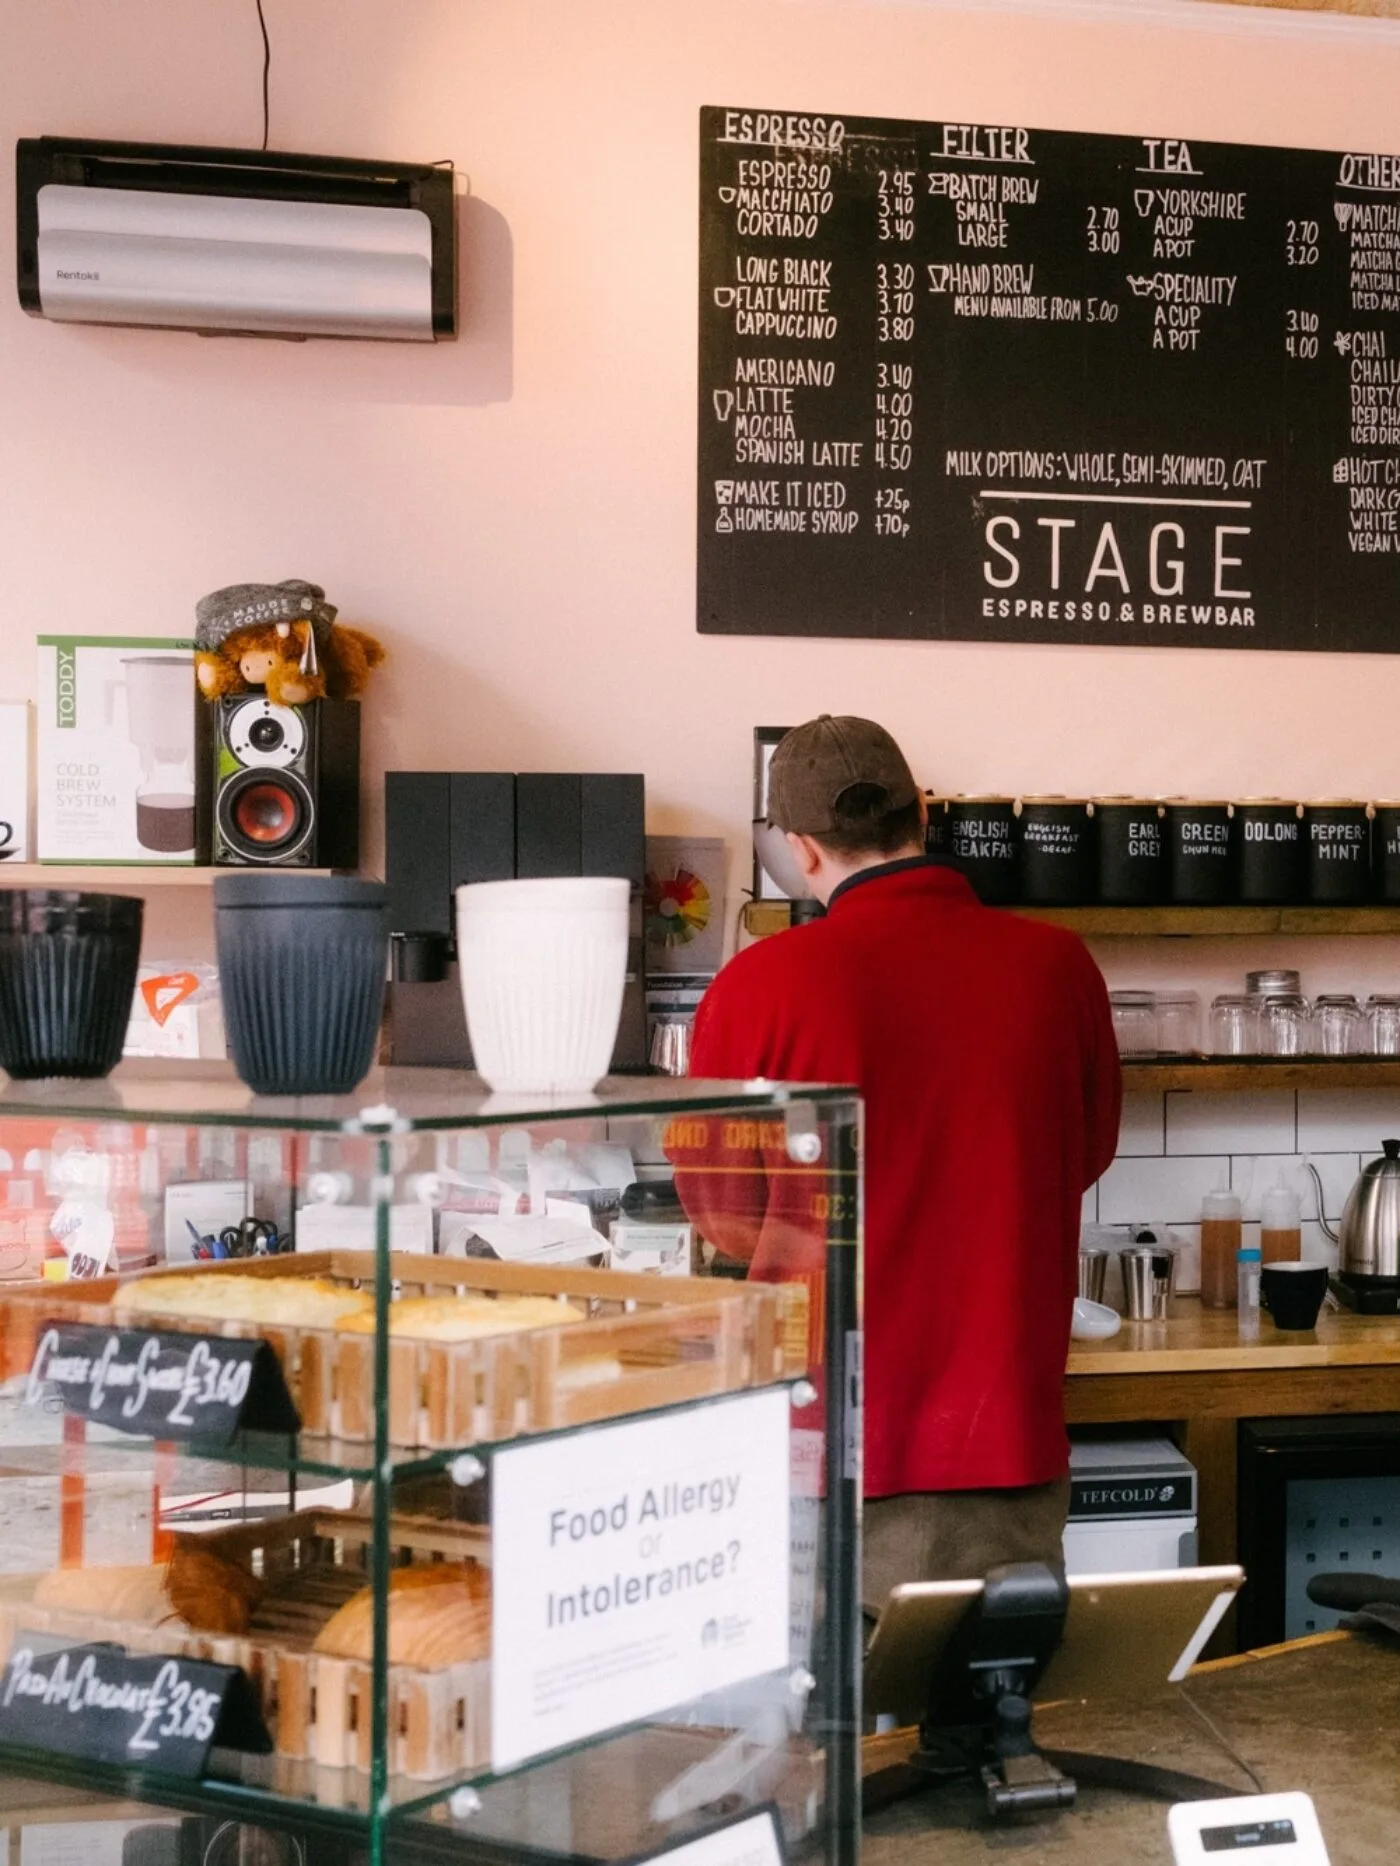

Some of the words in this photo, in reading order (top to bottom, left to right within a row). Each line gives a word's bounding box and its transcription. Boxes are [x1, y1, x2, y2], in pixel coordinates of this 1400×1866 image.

[724, 112, 845, 150] ESPRESSO
[942, 125, 1030, 161] FILTER
[1142, 140, 1194, 173] TEA
[738, 160, 831, 190] ESPRESSO
[878, 170, 916, 195] 2.95
[948, 173, 997, 202] BATCH
[1001, 178, 1039, 205] BREW
[736, 187, 834, 214] MACCHIATO
[877, 195, 915, 217] 3.40
[955, 200, 1007, 224] SMALL
[1086, 206, 1119, 231] 2.70
[1156, 189, 1248, 220] YORKSHIRE
[737, 209, 818, 238] CORTADO
[877, 218, 915, 241] 3.40
[957, 223, 1009, 248] LARGE
[1087, 231, 1121, 254] 3.00
[1285, 220, 1320, 245] 2.70
[1350, 232, 1400, 250] MATCHA
[736, 256, 779, 285] LONG
[784, 257, 832, 287] BLACK
[877, 263, 915, 290] 3.30
[1350, 251, 1393, 271] MATCHA
[948, 262, 991, 294] HAND
[992, 263, 1034, 295] BREW
[1152, 272, 1238, 306] SPECIALITY
[1350, 271, 1394, 291] MATCHA
[877, 290, 915, 315] 3.70
[954, 296, 989, 317] MENU
[990, 296, 1049, 320] AVAILABLE
[1050, 298, 1081, 321] FROM
[1085, 297, 1119, 324] 5.00
[1351, 291, 1380, 311] ICED
[735, 311, 837, 339] CAPPUCCINO
[877, 317, 915, 342] 3.80
[1154, 305, 1167, 327] A
[1168, 305, 1202, 327] CUP
[1285, 309, 1320, 334] 3.40
[1153, 328, 1165, 350] A
[1168, 329, 1201, 350] POT
[1285, 336, 1320, 359] 4.00
[1351, 330, 1386, 358] CHAI
[735, 357, 836, 387] AMERICANO
[876, 363, 913, 389] 3.40
[1350, 359, 1388, 384] CHAI
[735, 387, 796, 414] LATTE
[875, 393, 913, 417] 4.00
[1350, 385, 1395, 406] DIRTY
[735, 415, 796, 440] MOCHA
[875, 418, 912, 442] 4.20
[1351, 406, 1379, 426] ICED
[1350, 426, 1378, 445] ICED
[735, 437, 805, 466] SPANISH
[812, 441, 864, 469] LATTE
[874, 443, 912, 471] 4.50
[946, 451, 983, 477] MILK
[1232, 459, 1268, 489] OAT
[1350, 457, 1385, 485] HOT
[734, 480, 781, 507] MAKE
[786, 481, 800, 507] IT
[807, 481, 847, 509] ICED
[1350, 487, 1387, 511] DARK
[734, 507, 807, 534] HOMEMADE
[811, 510, 860, 535] SYRUP
[1349, 511, 1398, 532] WHITE
[1348, 531, 1391, 553] VEGAN
[983, 516, 1253, 600] STAGE
[982, 598, 1111, 622] ESPRESSO
[1118, 602, 1135, 623] &
[1142, 604, 1256, 628] BREWBAR
[58, 650, 74, 726] TODDY
[56, 762, 100, 777] COLD
[56, 778, 102, 792] BREW
[56, 794, 117, 808] SYSTEM
[952, 820, 1009, 839] ENGLISH
[1128, 822, 1160, 839] EARL
[1181, 822, 1229, 842] GREEN
[1244, 821, 1299, 842] OOLONG
[1318, 844, 1361, 861] MINT
[1080, 1487, 1156, 1505] TEFCOLD
[549, 1493, 629, 1550] Food
[638, 1472, 742, 1526] Allergy
[638, 1530, 664, 1560] or
[547, 1538, 742, 1630] Intolerance?
